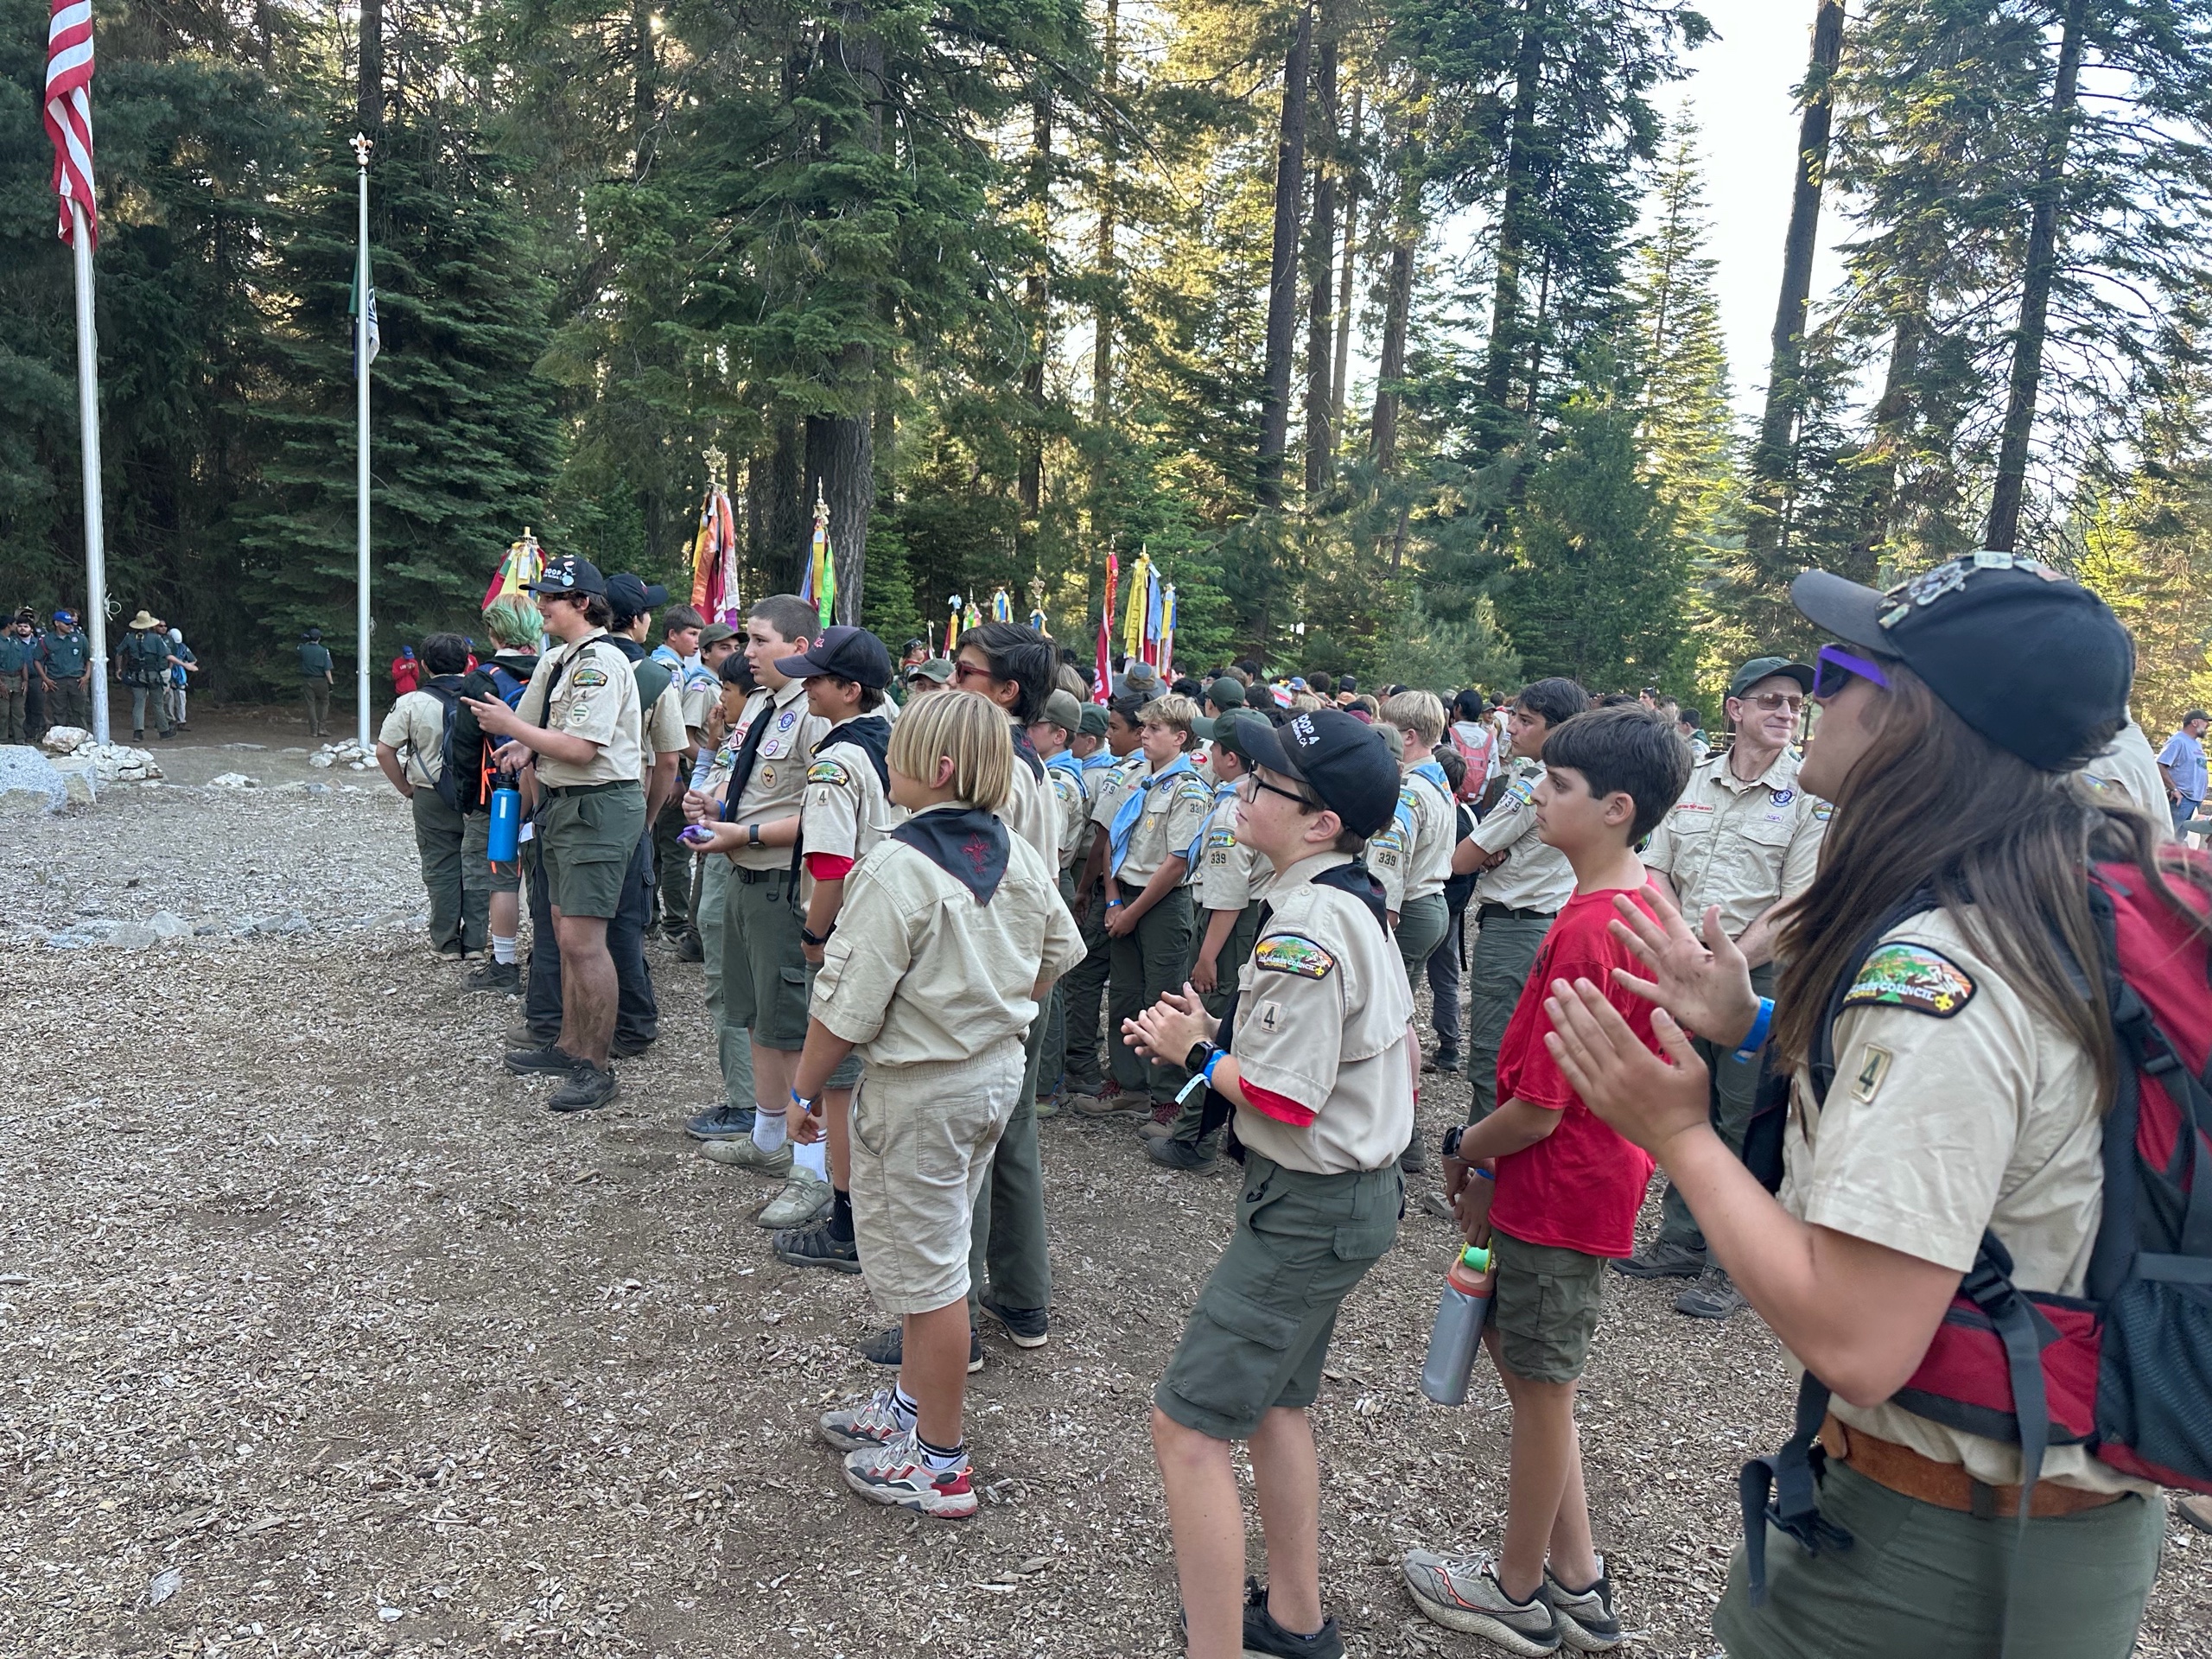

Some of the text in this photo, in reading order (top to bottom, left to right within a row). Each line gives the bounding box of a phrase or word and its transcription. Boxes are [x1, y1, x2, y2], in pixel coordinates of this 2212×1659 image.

[581, 690, 587, 700] 4
[1299, 737, 1307, 748] CA
[1308, 736, 1320, 745] 4
[1103, 783, 1116, 795] 39
[818, 790, 827, 804] 4
[1211, 853, 1226, 864] 339
[1378, 852, 1396, 867] 339
[1287, 959, 1315, 971] COUNCIL
[1878, 982, 1936, 1001] COUNCIL
[1263, 1006, 1275, 1029] 4
[1859, 1053, 1882, 1093] 4
